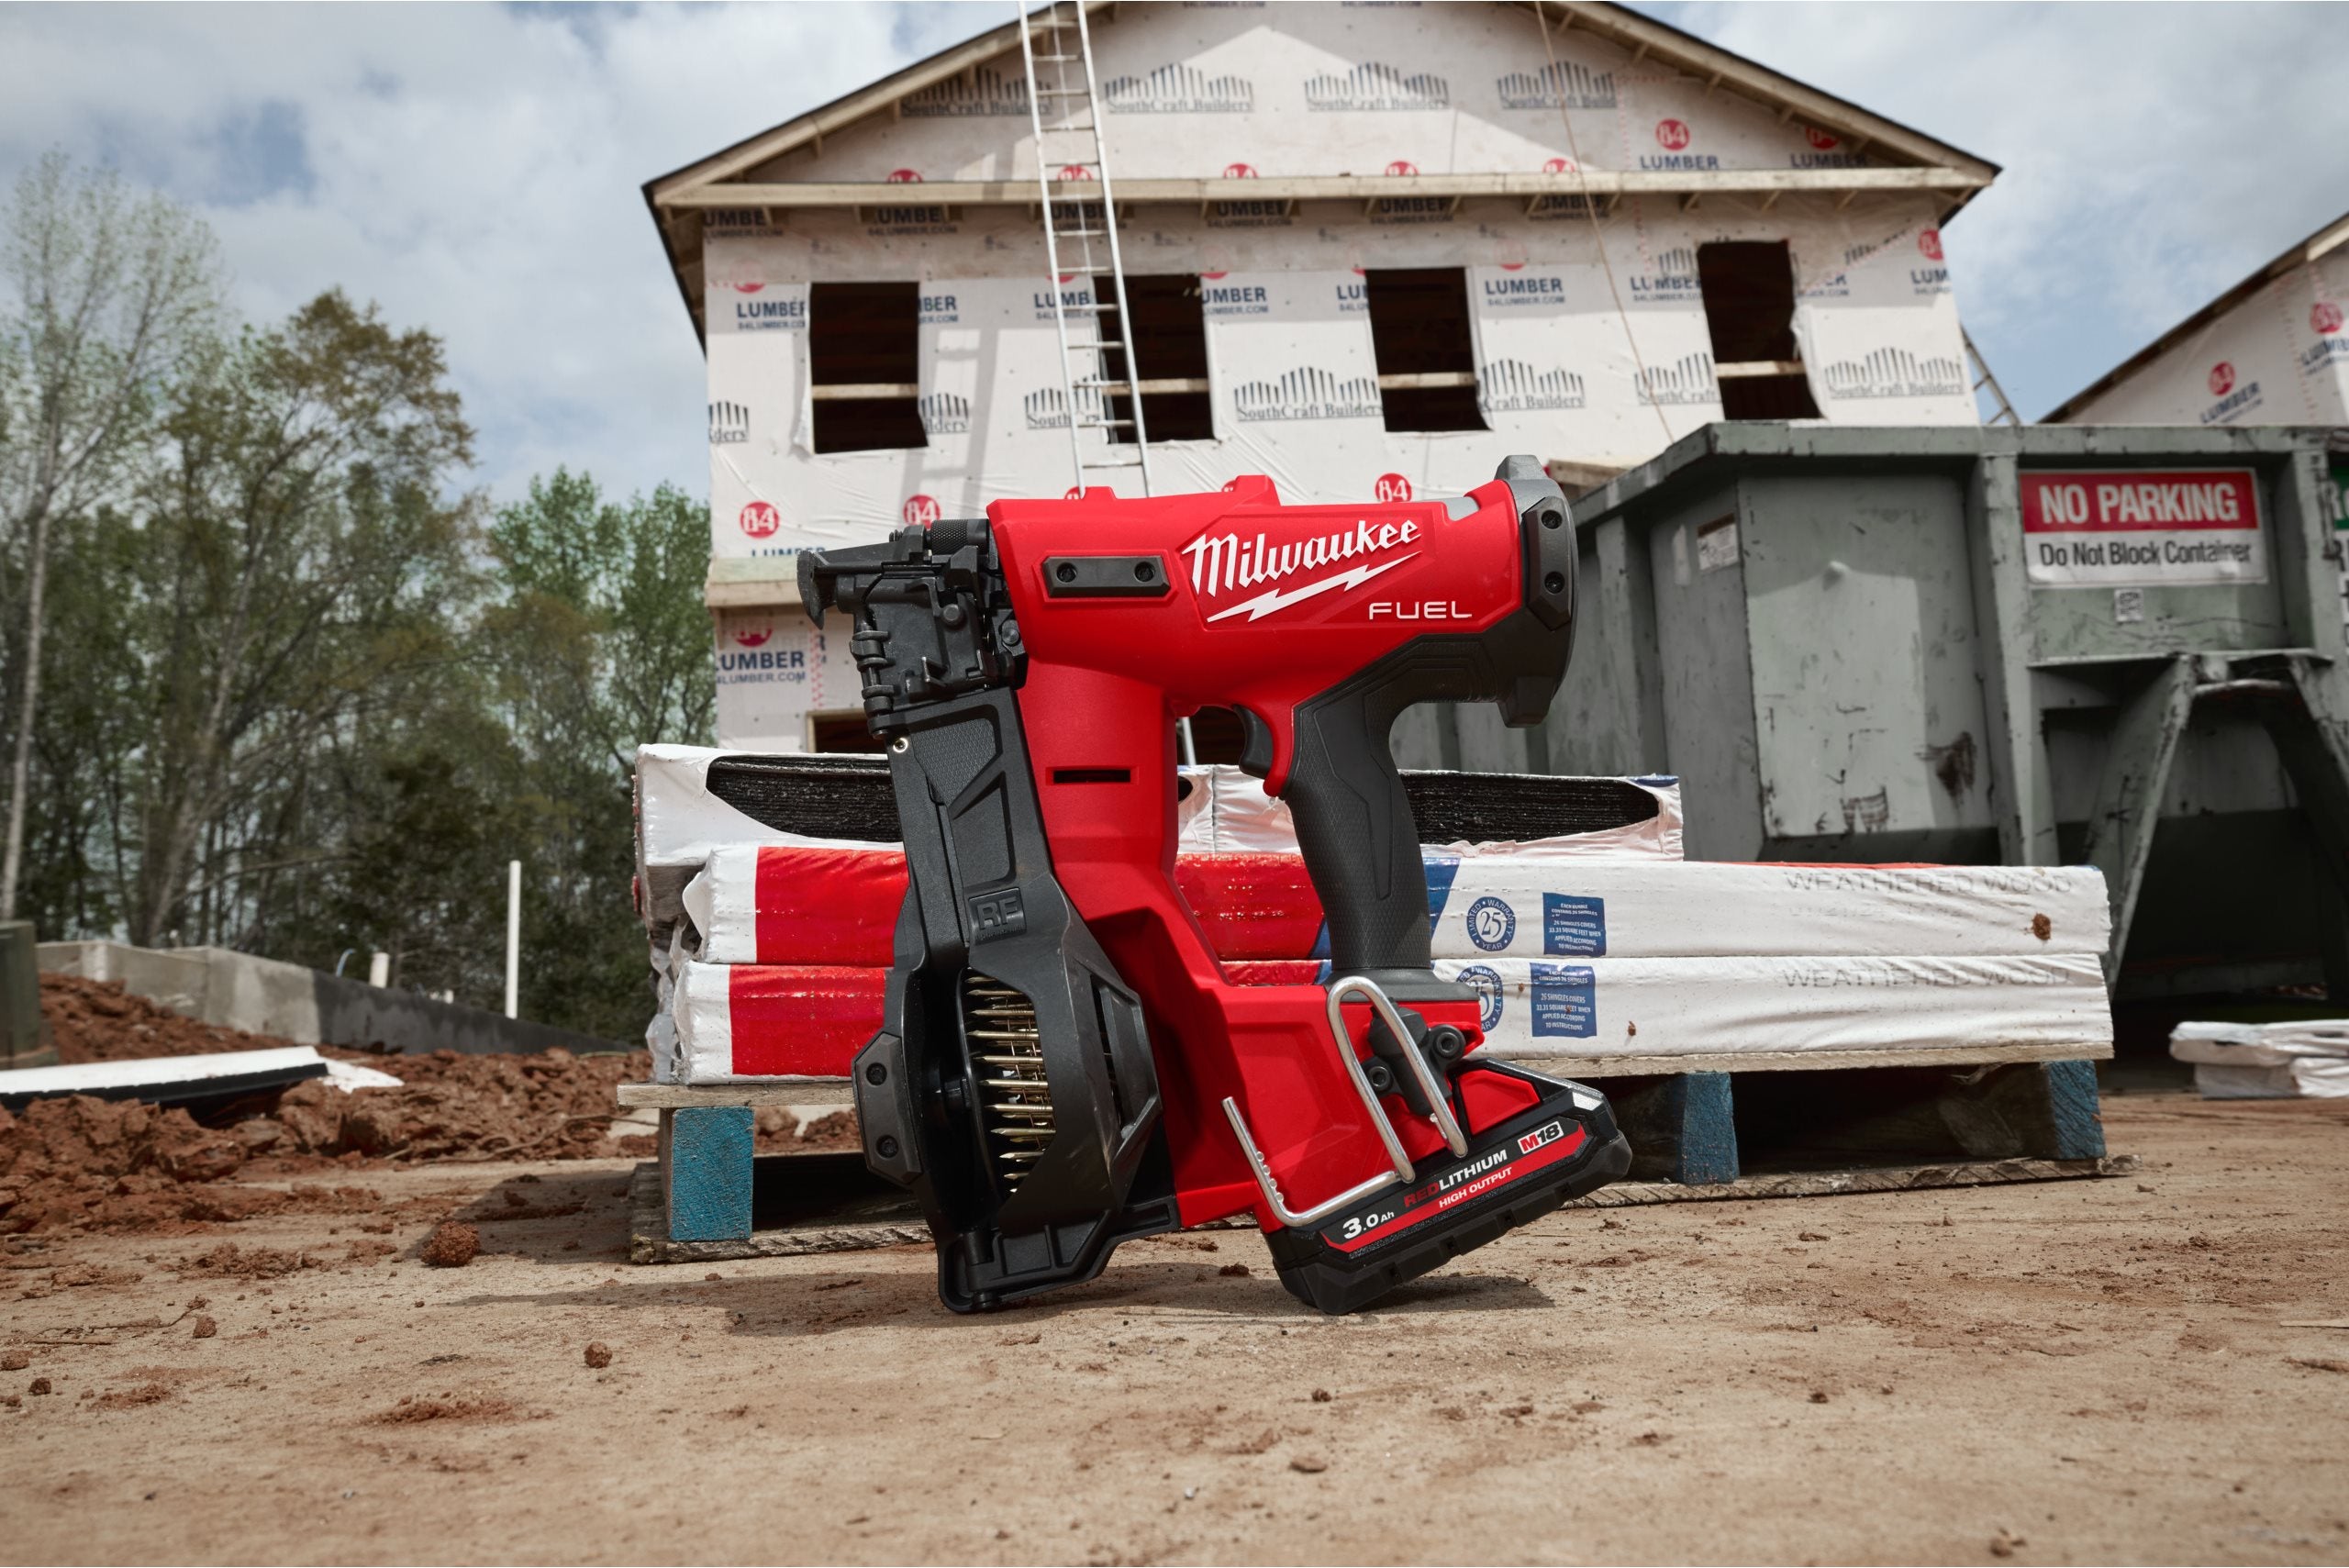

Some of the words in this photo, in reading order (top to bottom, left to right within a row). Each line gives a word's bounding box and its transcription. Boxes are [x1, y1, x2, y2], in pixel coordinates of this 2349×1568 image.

[1660, 124, 1687, 145] 84
[1640, 155, 1720, 170] LUMBER
[1202, 287, 1267, 304] UMBER
[1485, 278, 1563, 295] LUMBER
[1238, 403, 1319, 419] SouthCraft
[1377, 480, 1408, 502] 84
[2039, 484, 2089, 523] NO
[2097, 483, 2241, 523] PARKING
[742, 506, 775, 533] 84
[1182, 519, 1422, 596] Milwaukee
[2040, 542, 2067, 566] Do
[2073, 542, 2105, 565] Not
[2110, 541, 2161, 565] Block
[2165, 541, 2251, 563] Container
[1369, 601, 1473, 619] FUEL
[716, 651, 805, 672] UMBER
[1784, 872, 1973, 893] WEATHERED
[1983, 873, 2072, 894] WOOD
[976, 895, 1019, 930] RF
[1468, 903, 1482, 937] LIMITED
[1486, 899, 1514, 938] WARRANTY
[1480, 910, 1502, 938] 25
[1482, 942, 1503, 951] YEAR
[1573, 938, 1598, 946] ACCORDING
[1782, 967, 1972, 987] WEATHERED
[1547, 994, 1569, 1002] SHINGLES
[1569, 995, 1586, 1004] COVERS
[1552, 1022, 1583, 1031] INSTRUCTIONS
[1561, 1014, 1586, 1022] ACCORDING
[1519, 1121, 1561, 1153] M18
[1403, 1150, 1508, 1208] REDLITHIUM
[1438, 1187, 1468, 1209] HIGH
[1468, 1167, 1513, 1194] OUTPUT
